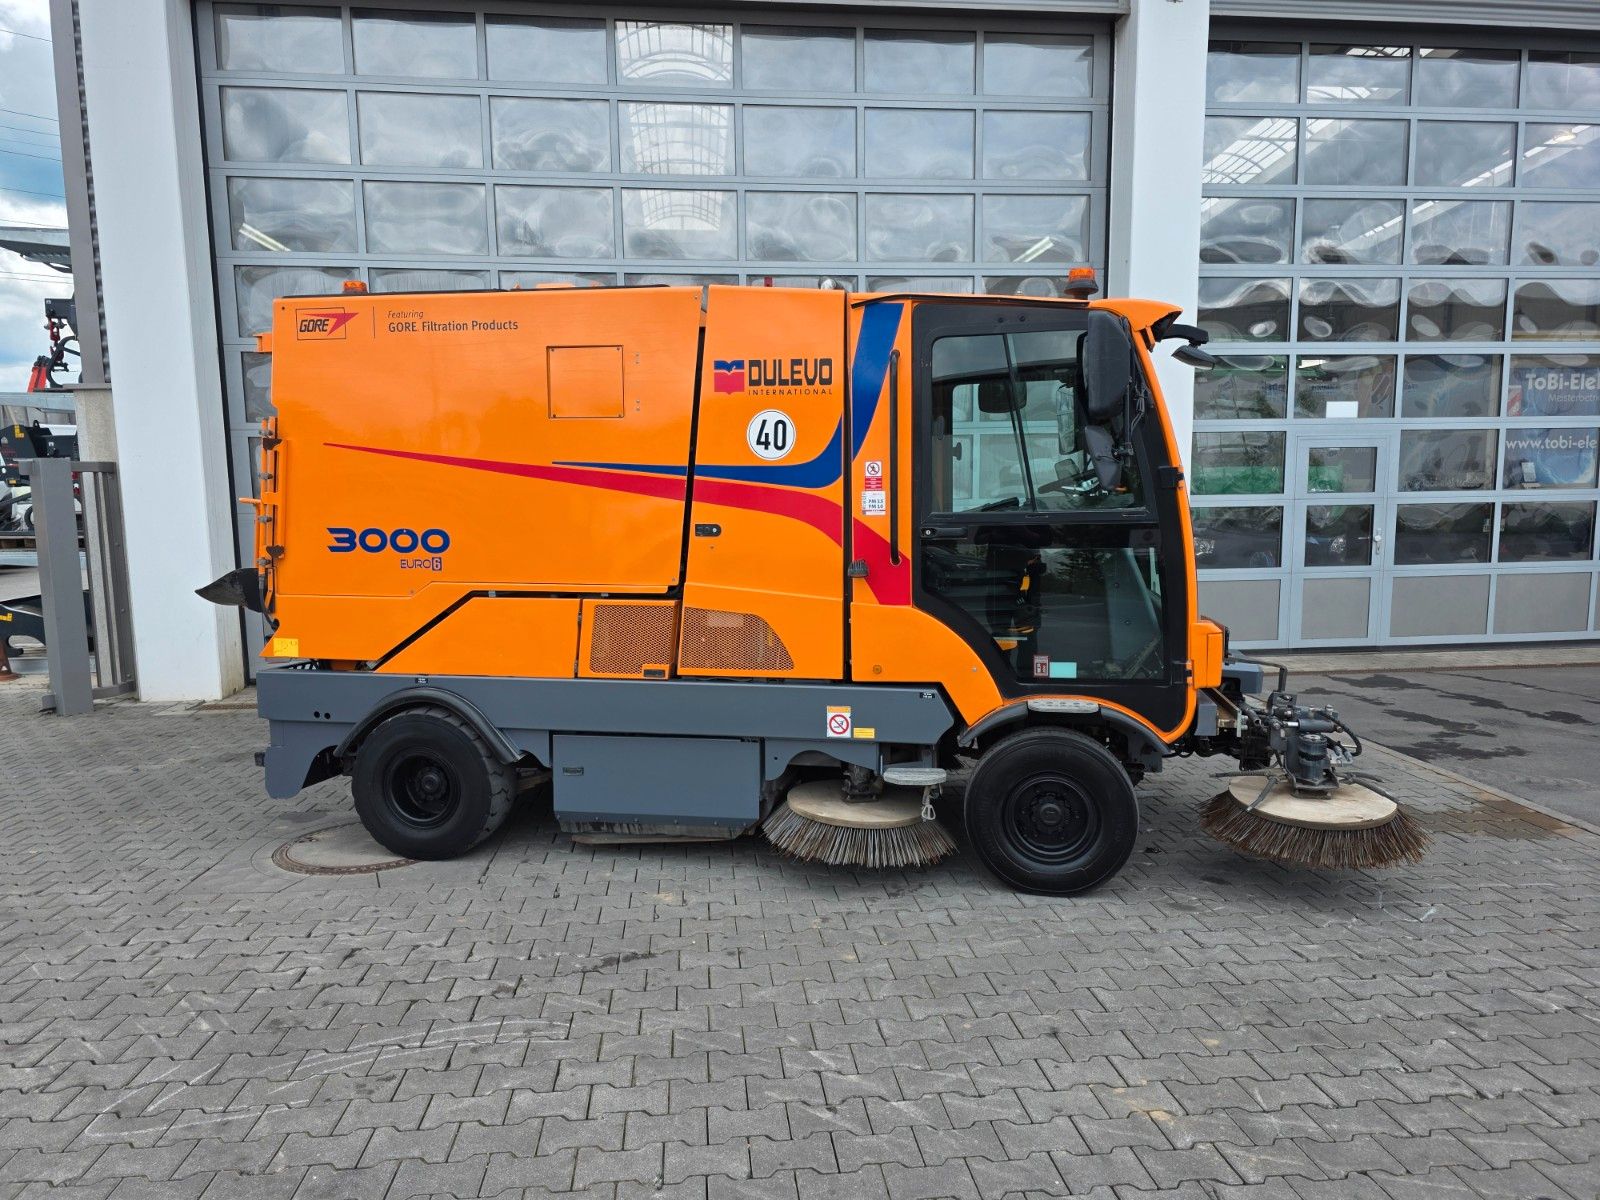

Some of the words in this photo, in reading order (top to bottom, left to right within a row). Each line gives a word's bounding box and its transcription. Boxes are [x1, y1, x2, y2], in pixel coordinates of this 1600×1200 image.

[387, 309, 424, 319] Featuring
[299, 319, 329, 333] GORE
[388, 321, 417, 332] GORE
[422, 320, 468, 332] Filtration
[471, 319, 519, 331] Products
[748, 358, 832, 386] DULEVO
[748, 388, 832, 396] INTERNATIONAL
[756, 419, 787, 450] 40
[326, 527, 450, 553] 3000
